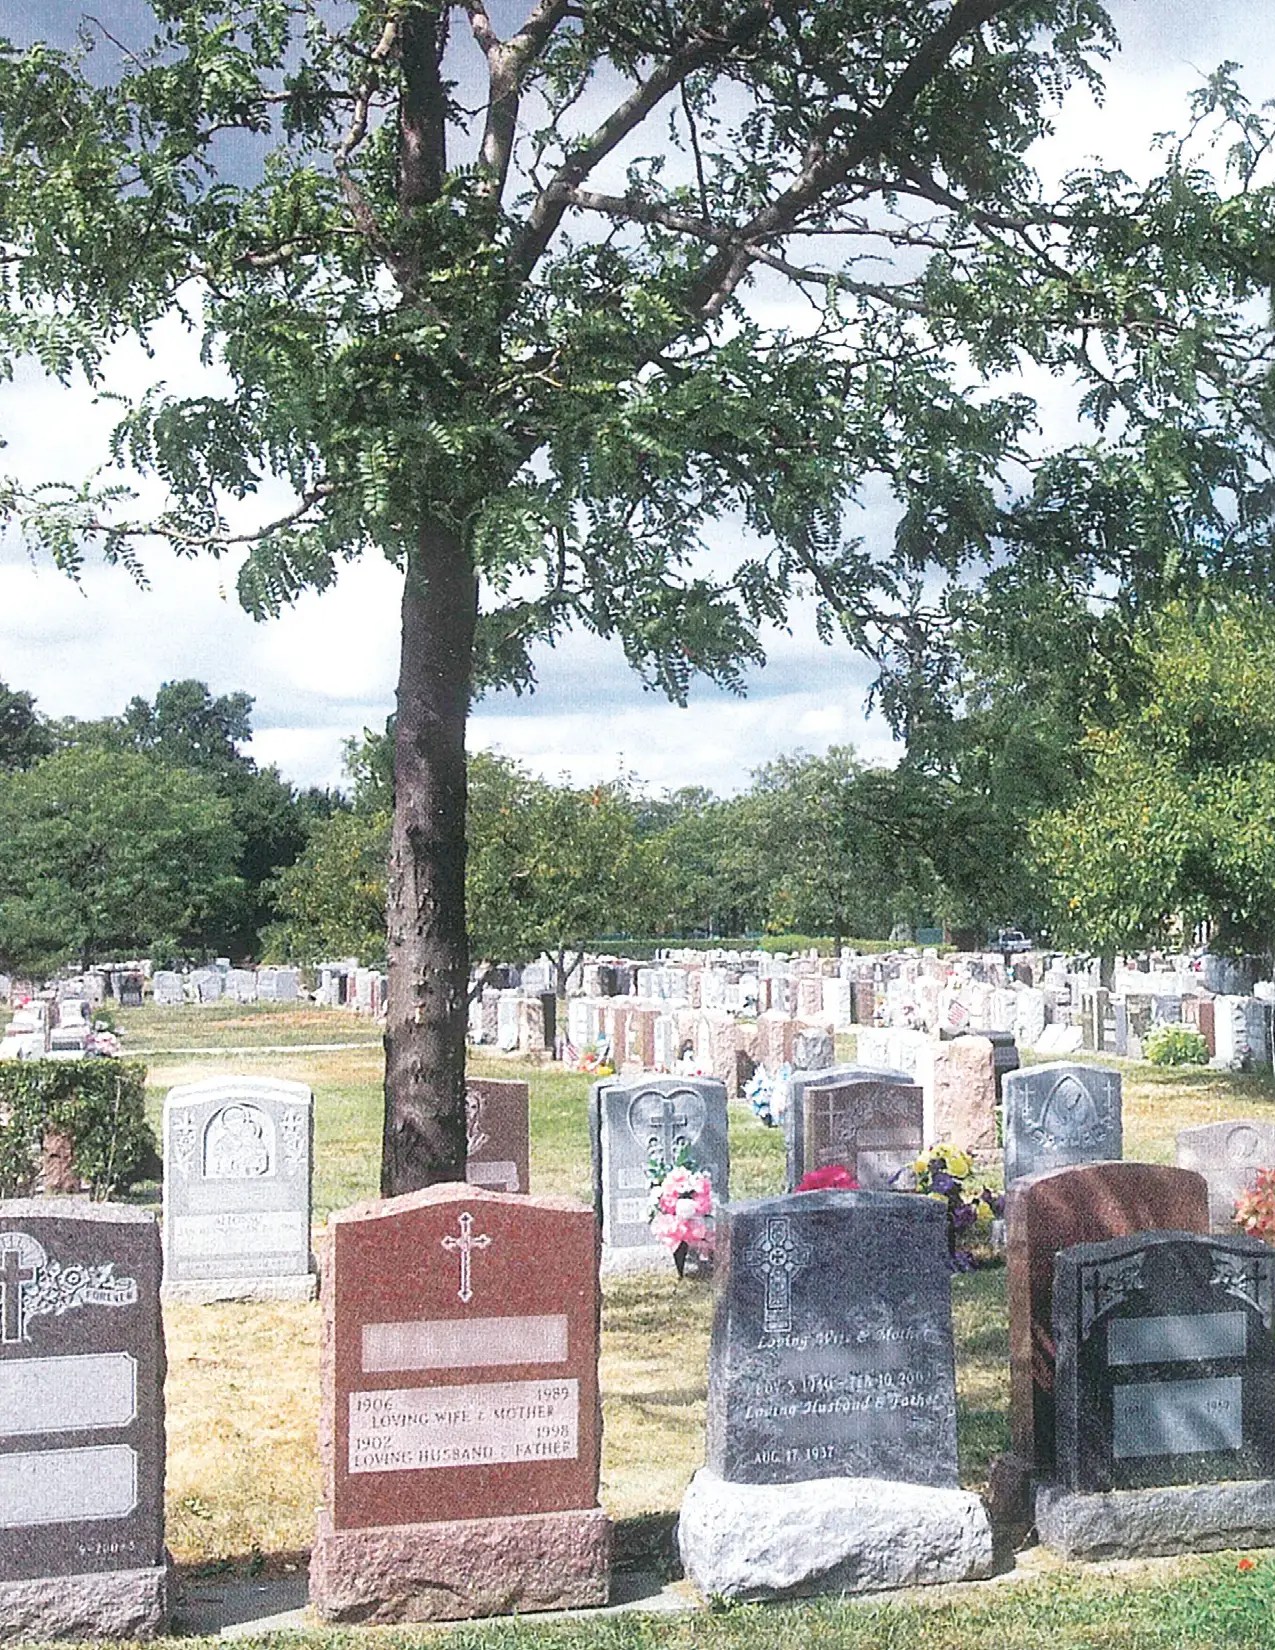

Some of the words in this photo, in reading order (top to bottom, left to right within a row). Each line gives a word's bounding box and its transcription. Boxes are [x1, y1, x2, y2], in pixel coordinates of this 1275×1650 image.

[85, 1289, 133, 1302] FOREVER
[758, 1332, 808, 1350] Loving
[537, 1387, 569, 1402] 1989
[356, 1397, 393, 1412] 1906
[745, 1403, 797, 1420] Loving
[802, 1396, 871, 1416] Husband
[372, 1414, 429, 1430] LOVING
[435, 1410, 471, 1425] WIFE
[494, 1404, 555, 1420] MOTHER
[536, 1425, 569, 1440] 1998
[356, 1435, 392, 1450] 1902
[354, 1449, 413, 1468] LOVING
[418, 1446, 494, 1464] HUSBAND
[516, 1441, 570, 1457] FATHER
